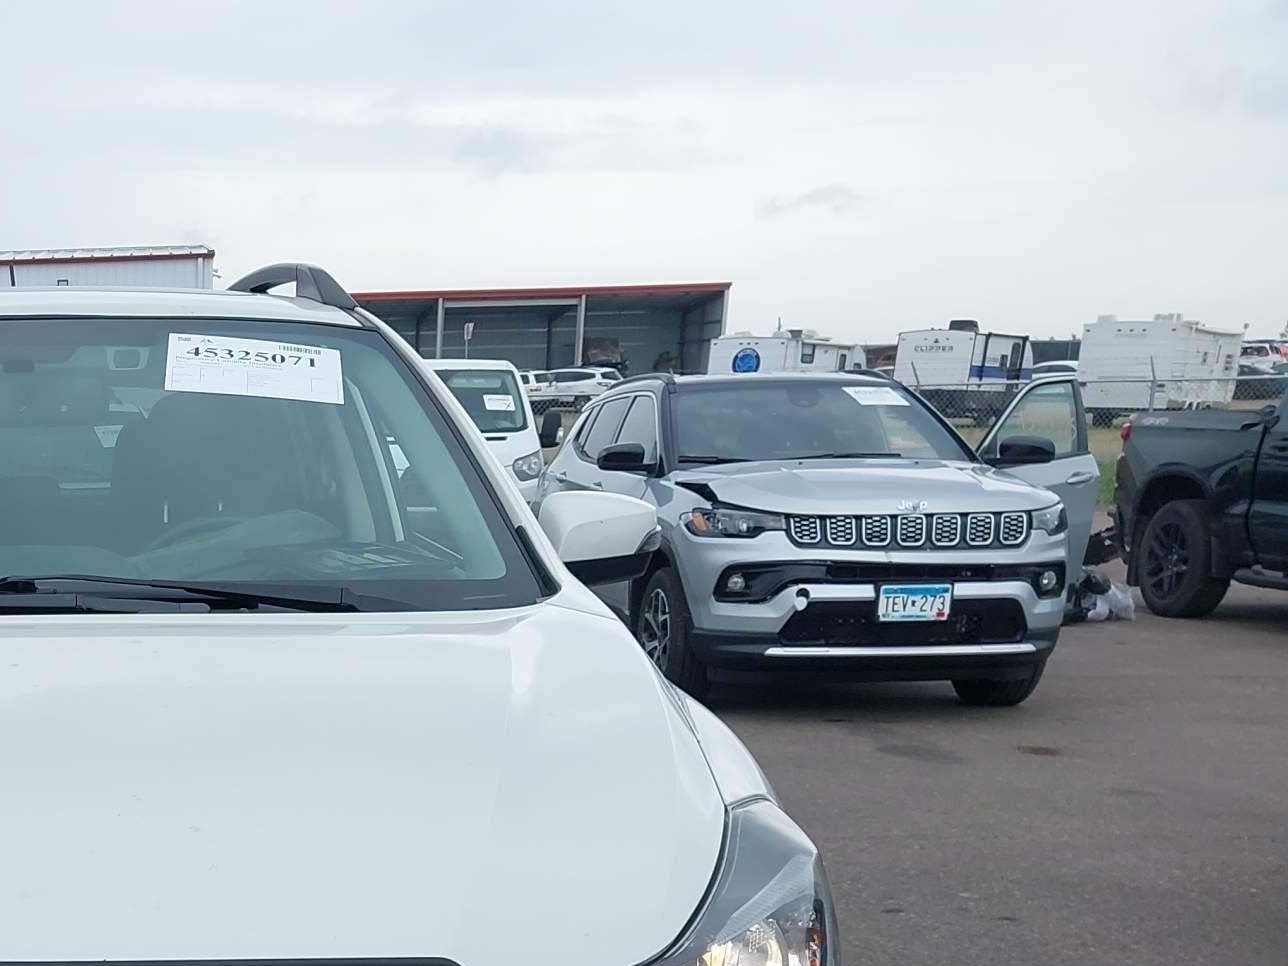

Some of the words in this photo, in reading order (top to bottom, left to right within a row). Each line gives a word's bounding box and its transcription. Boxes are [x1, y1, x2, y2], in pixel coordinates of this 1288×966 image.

[186, 346, 317, 368] 45325071
[883, 595, 910, 613] TEV
[919, 594, 946, 612] 273
